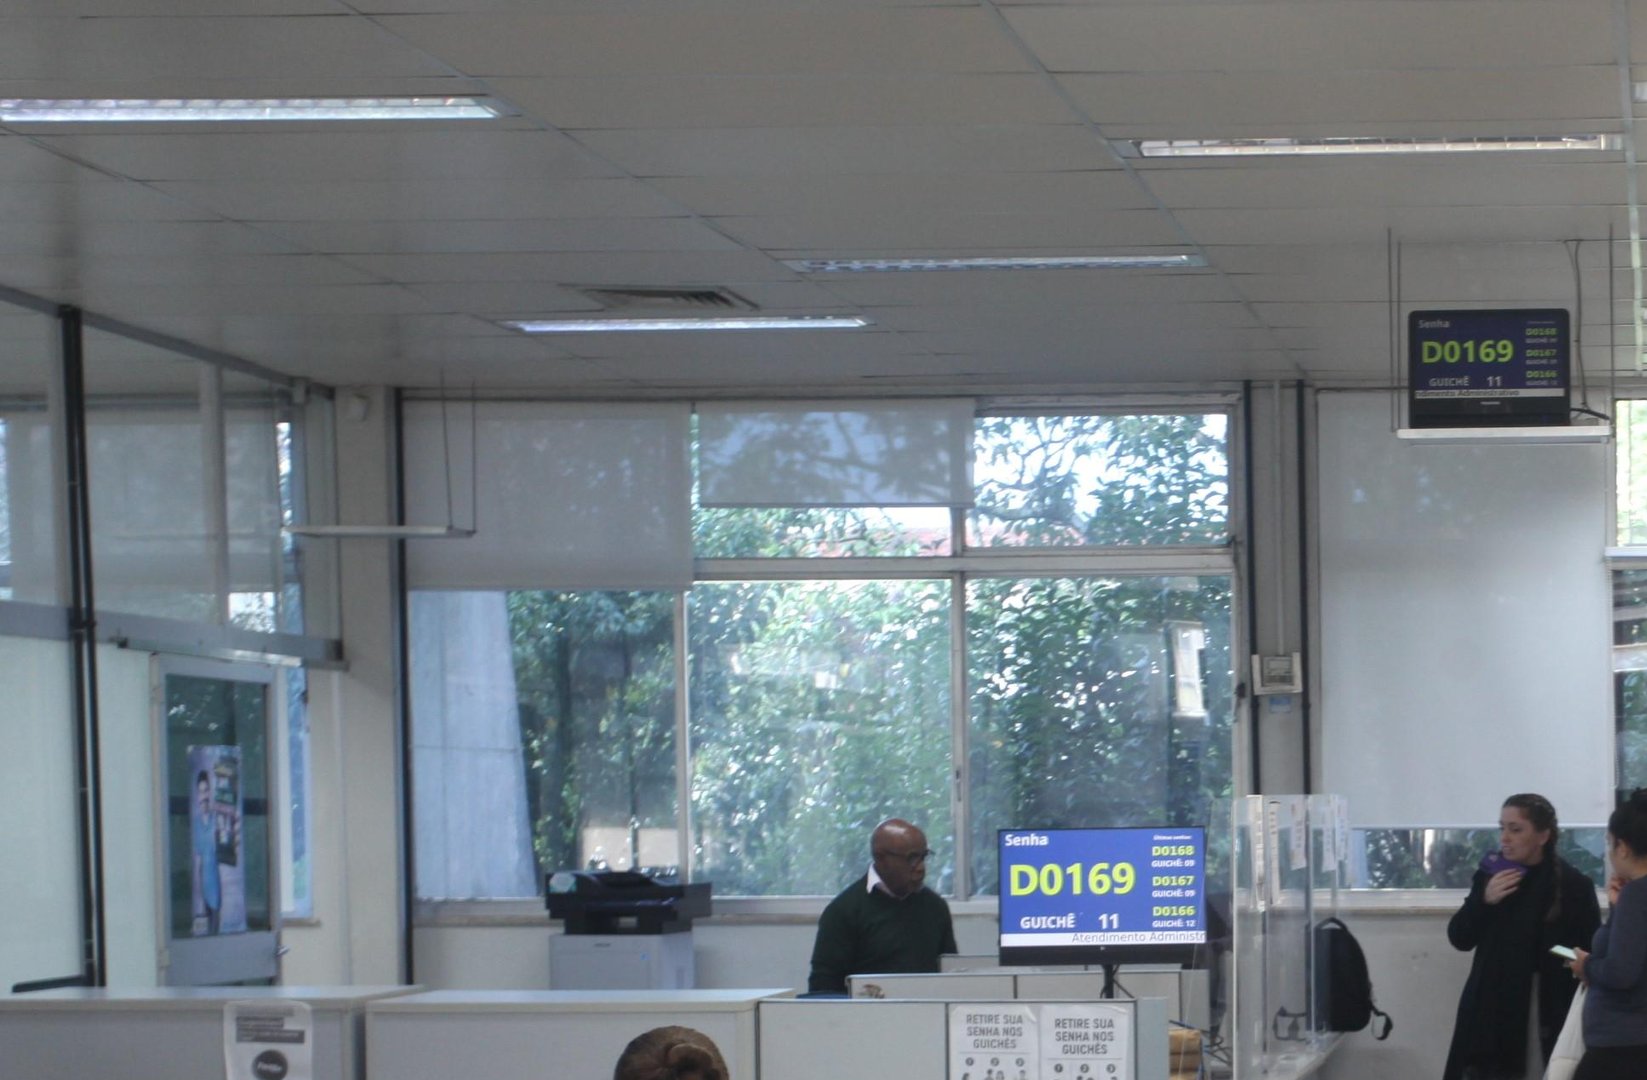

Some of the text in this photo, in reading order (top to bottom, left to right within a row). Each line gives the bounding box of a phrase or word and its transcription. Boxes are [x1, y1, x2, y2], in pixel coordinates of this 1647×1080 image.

[1418, 319, 1450, 329] Senha
[1422, 340, 1514, 363] D0169
[1429, 375, 1502, 387] GUICHÊ 11
[1005, 833, 1049, 847] Senha
[1152, 845, 1195, 856] D0168
[1010, 861, 1137, 897] D0169
[1152, 875, 1195, 887] D0167
[1153, 906, 1196, 917] D0166
[1020, 912, 1120, 930] GUICHÊ 11
[1186, 919, 1196, 928] 12
[1072, 932, 1147, 943] Atendimento
[966, 1014, 1024, 1025] RETIRE SUA
[1054, 1018, 1115, 1029] RETIRE SUA
[966, 1026, 1023, 1037] SENHA NOS
[1055, 1031, 1114, 1042] SENHA NOS
[973, 1038, 1017, 1049] GUICHÊS
[1062, 1043, 1108, 1055] GUICHÊS
